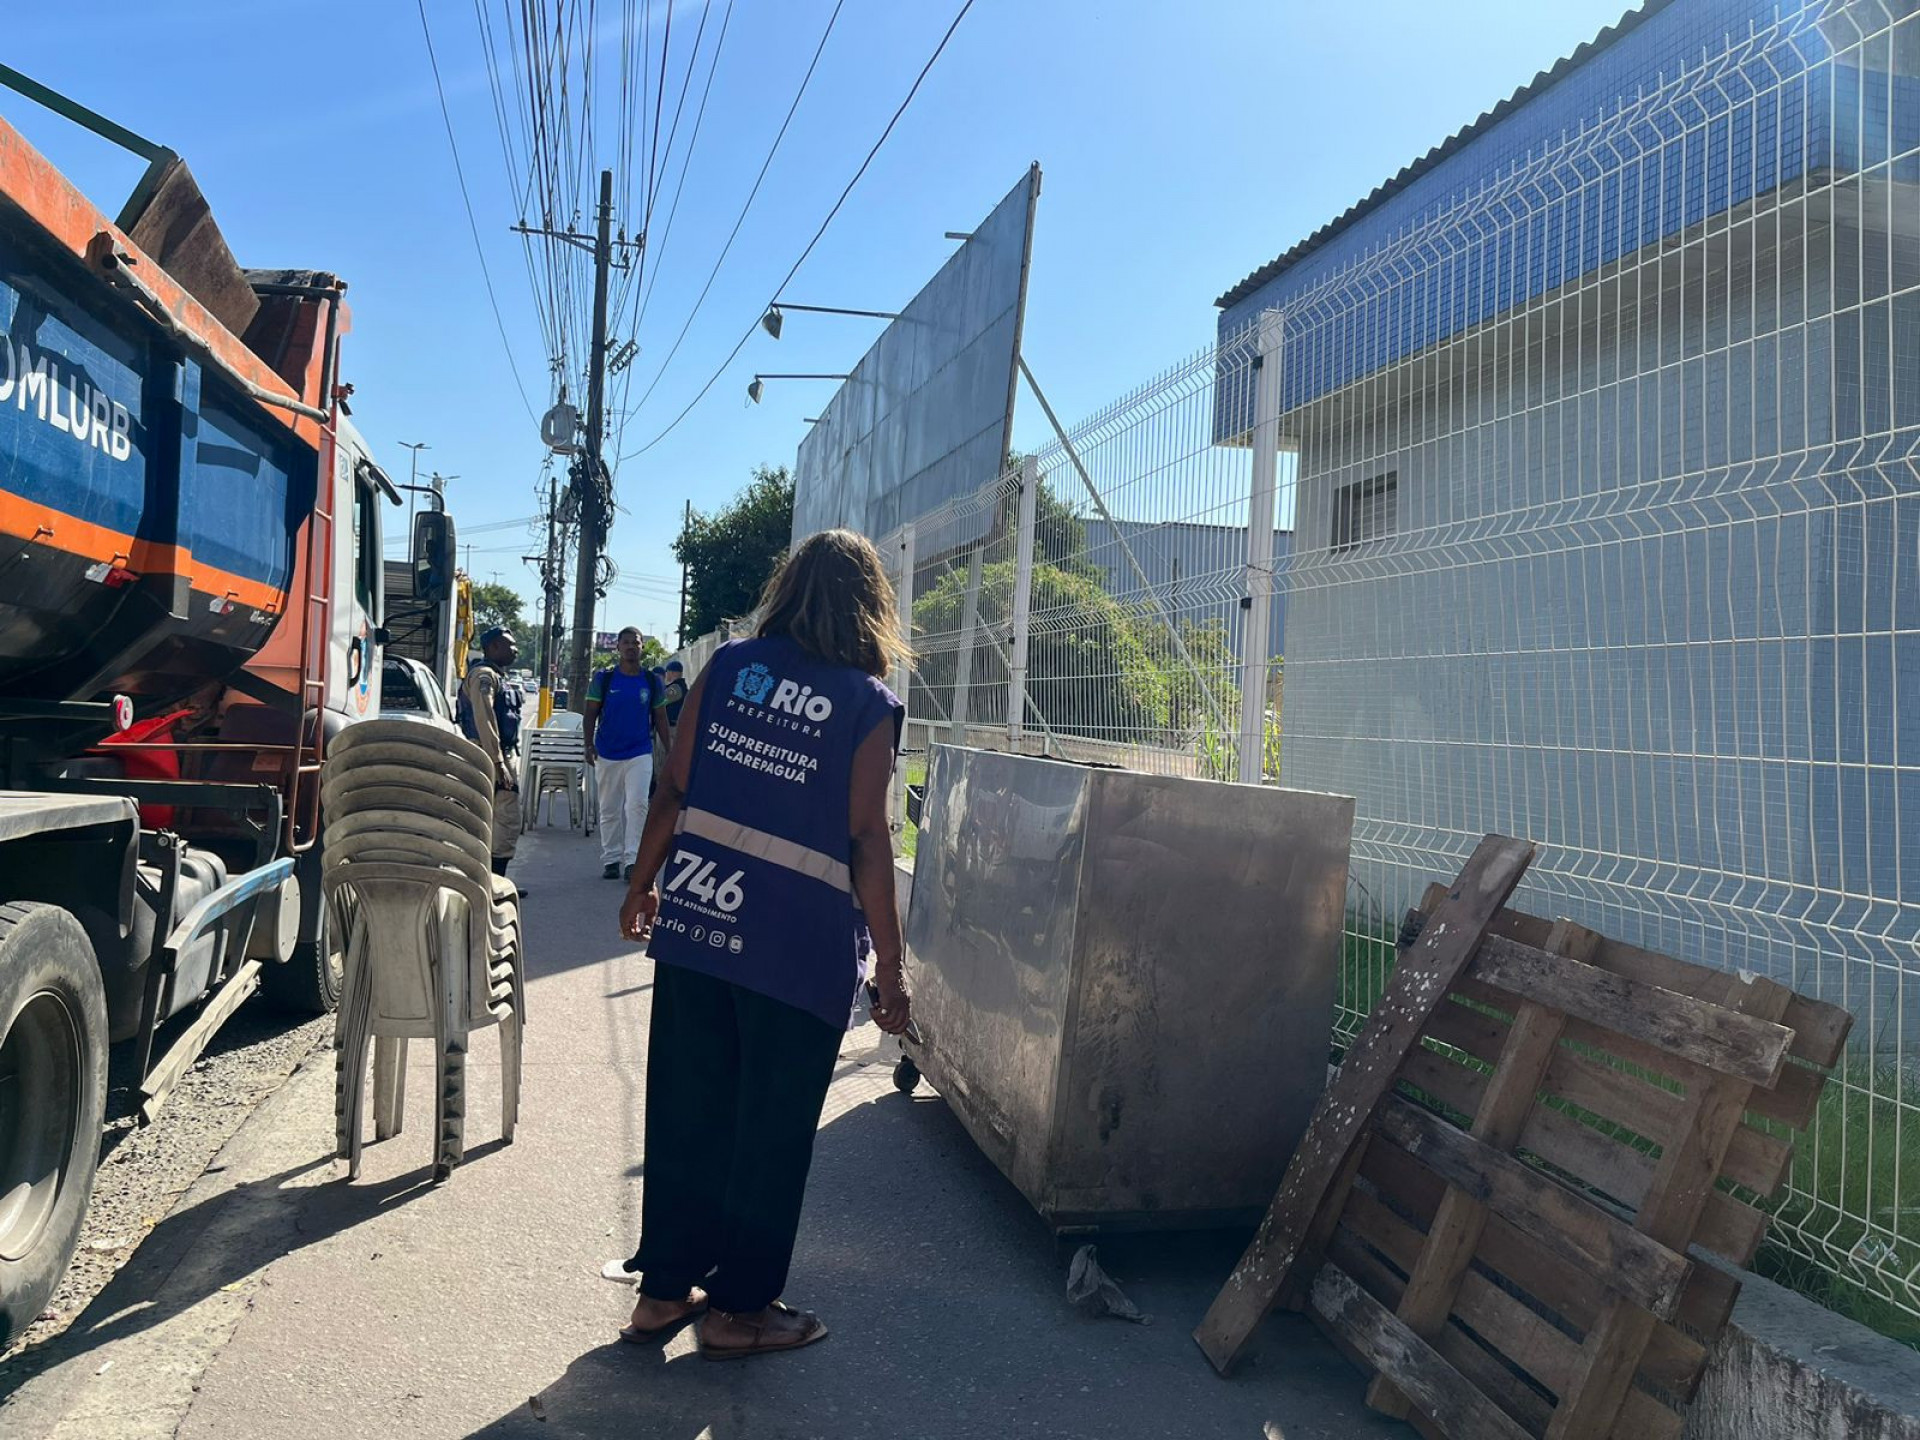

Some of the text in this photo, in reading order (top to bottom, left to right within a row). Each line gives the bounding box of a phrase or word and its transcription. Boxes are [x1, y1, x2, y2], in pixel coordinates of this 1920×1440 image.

[727, 700, 821, 738] PREFEITURA
[770, 679, 832, 721] Rio
[707, 740, 806, 784] JACAREPAGUÁ
[708, 722, 818, 770] SUBPREFEITURA
[672, 896, 684, 906] DE
[684, 901, 737, 924] ATENDIMENTO
